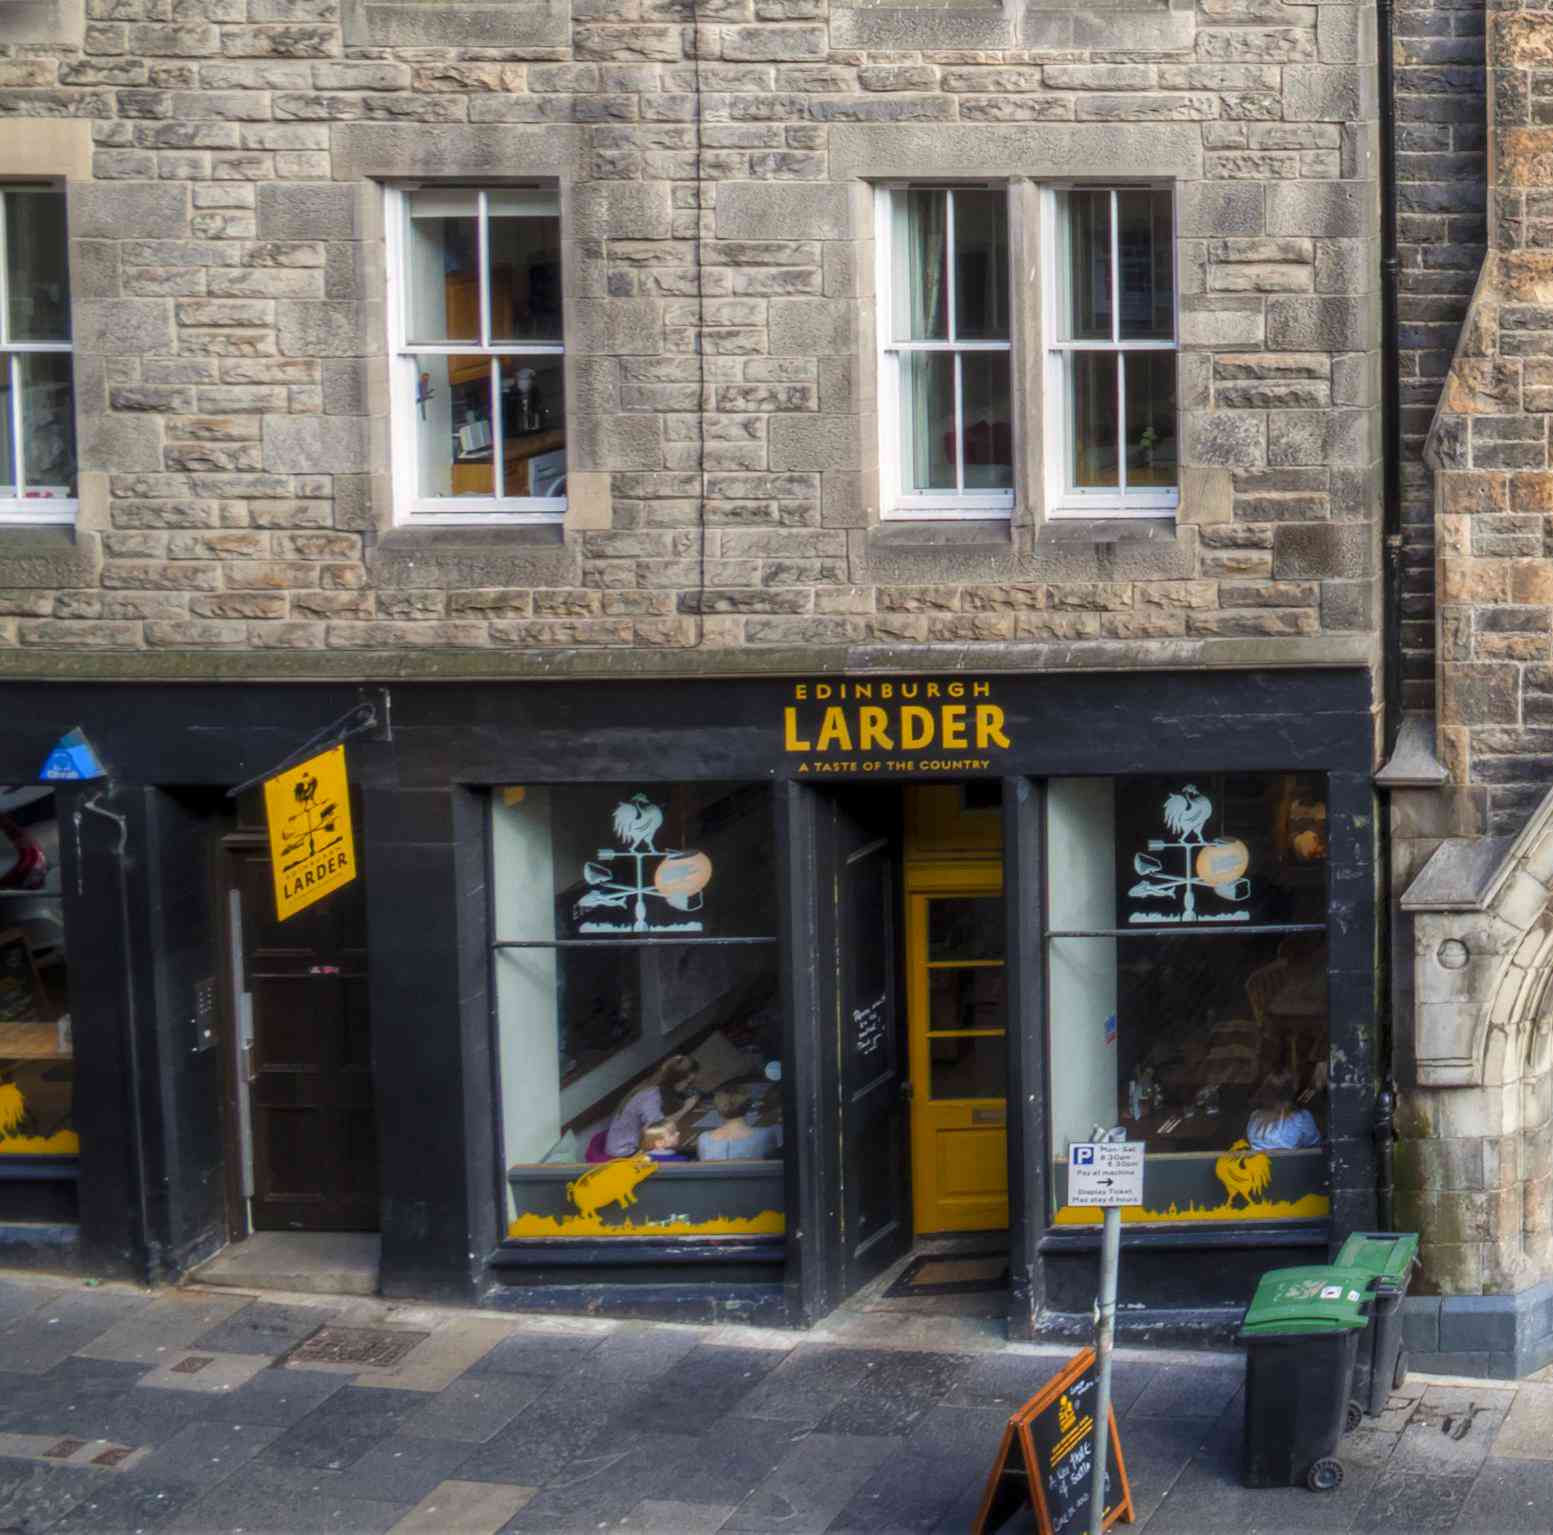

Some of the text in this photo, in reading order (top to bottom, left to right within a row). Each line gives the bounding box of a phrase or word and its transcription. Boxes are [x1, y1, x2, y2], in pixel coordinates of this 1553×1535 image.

[795, 682, 990, 700] EDINBURGH
[784, 704, 1010, 752] LARDER
[799, 759, 990, 773] A TASTE OF THE COUNTRY
[284, 852, 348, 899] LARDER
[1077, 1148, 1092, 1164] P
